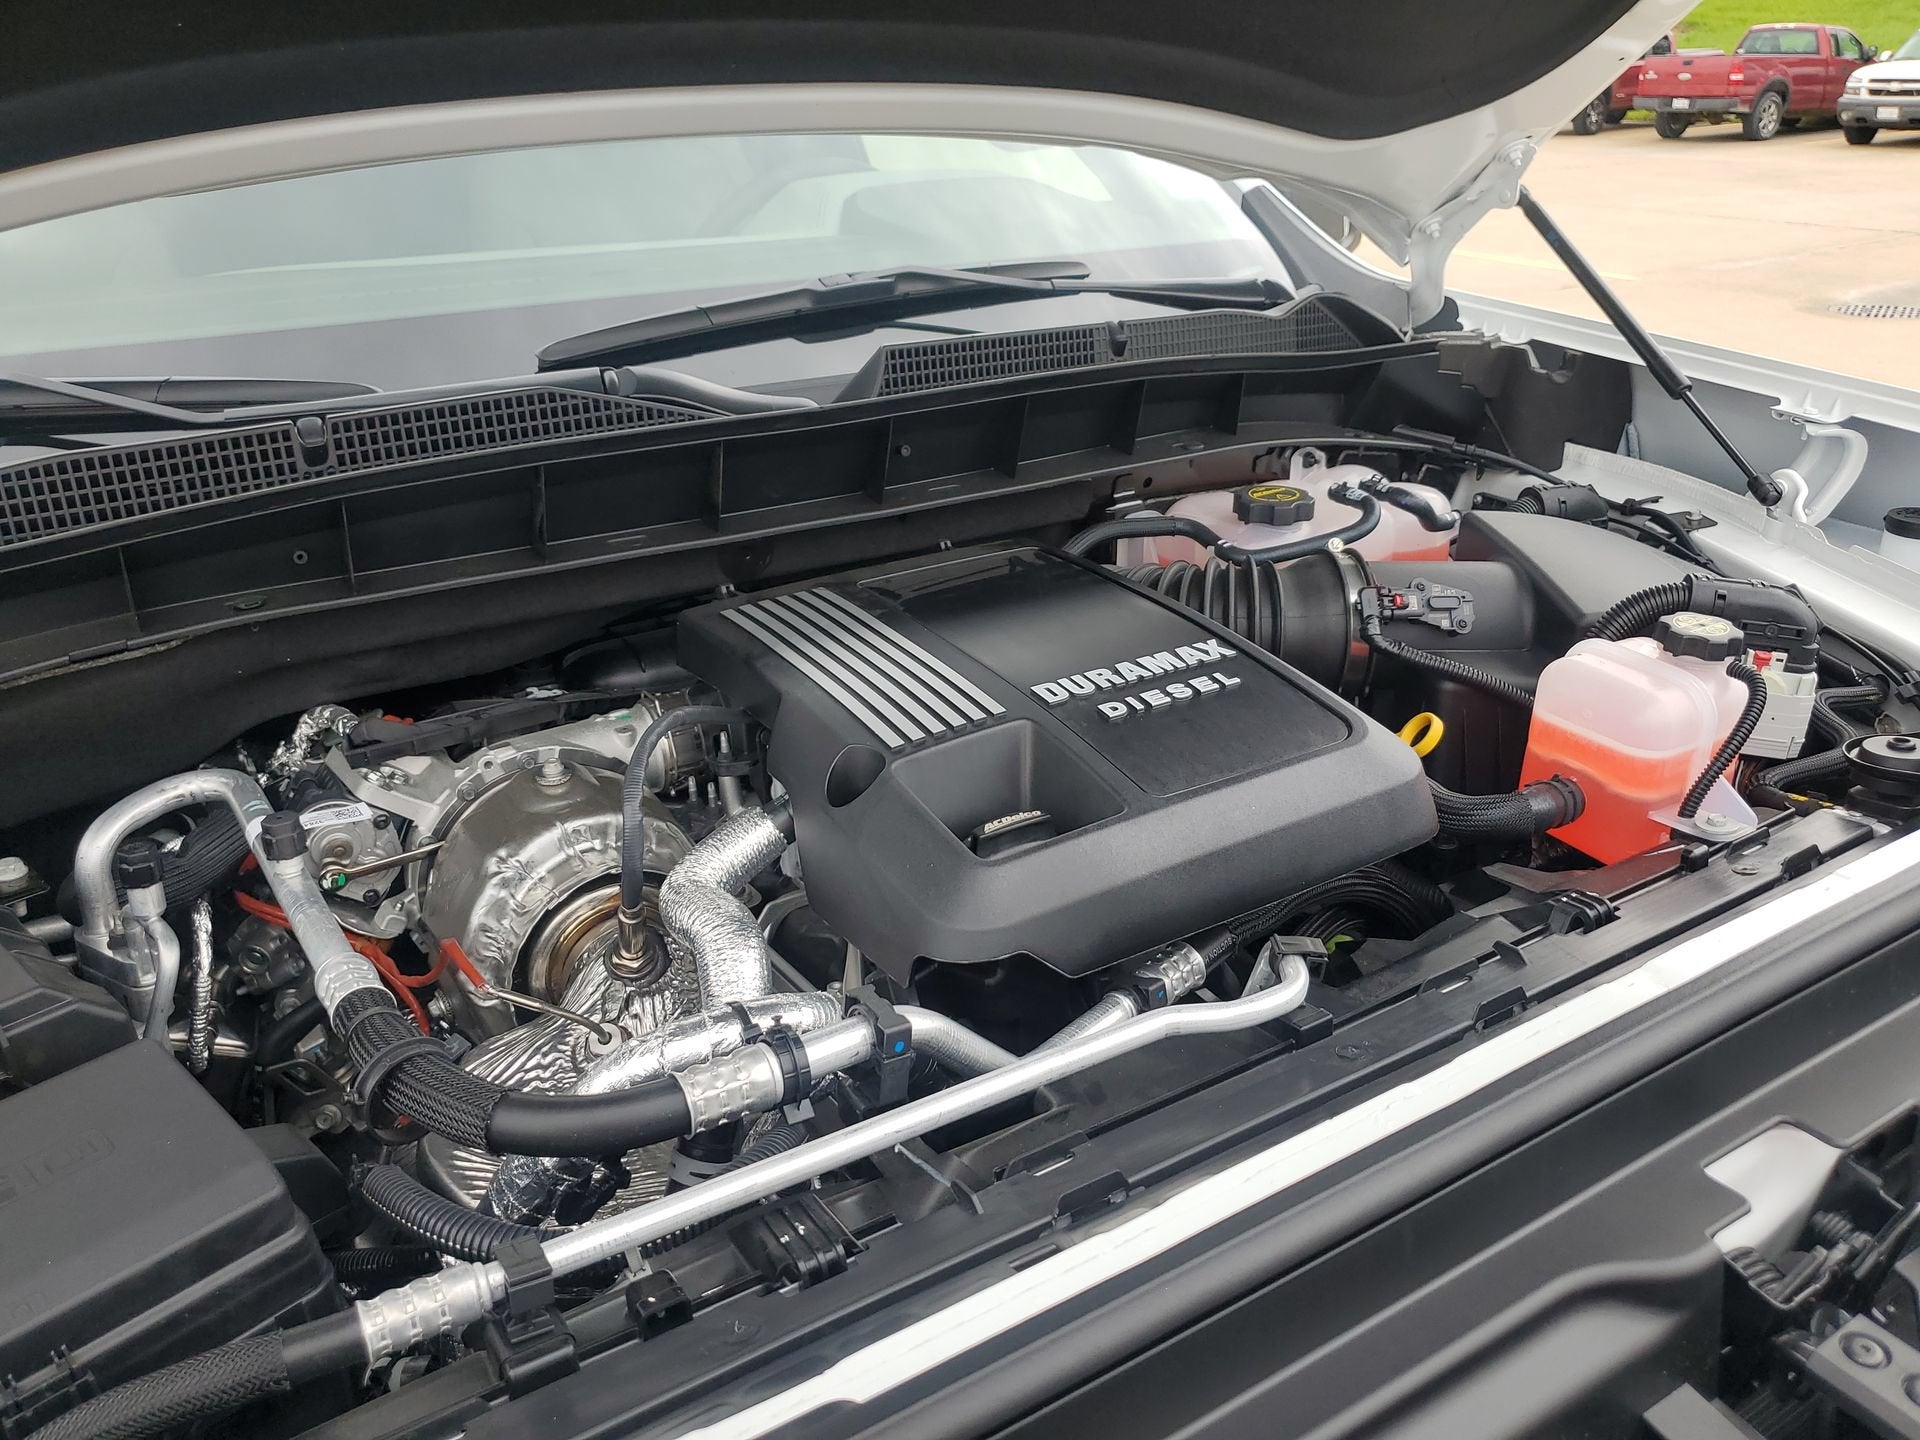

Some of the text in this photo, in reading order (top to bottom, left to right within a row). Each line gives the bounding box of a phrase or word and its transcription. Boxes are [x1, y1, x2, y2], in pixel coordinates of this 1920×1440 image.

[1030, 639, 1237, 704] DURAMAX
[1097, 672, 1241, 718] DIESEL
[984, 810, 1042, 833] ACDelco
